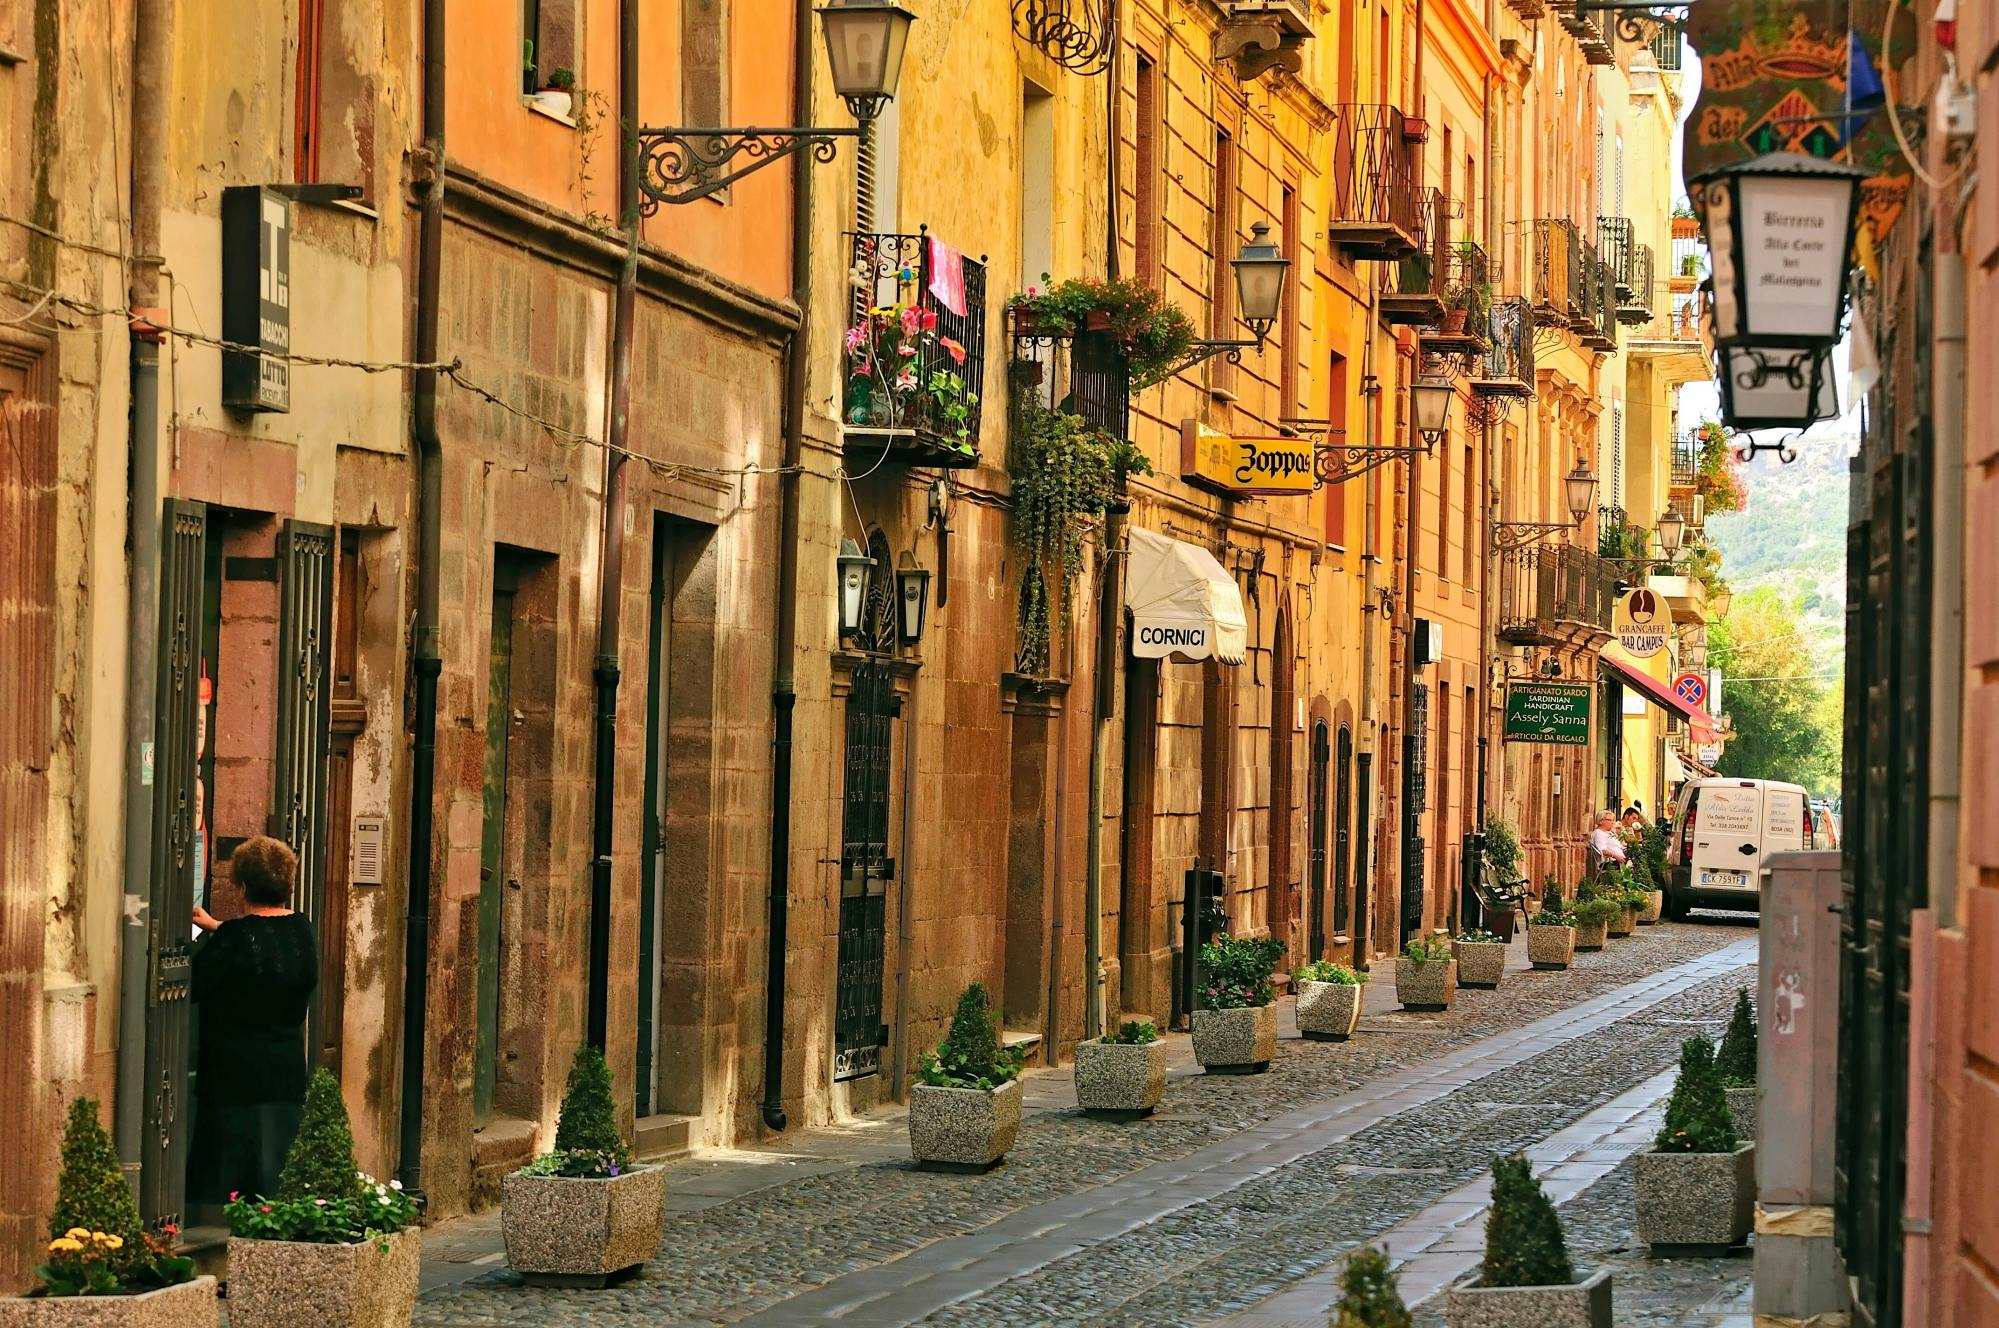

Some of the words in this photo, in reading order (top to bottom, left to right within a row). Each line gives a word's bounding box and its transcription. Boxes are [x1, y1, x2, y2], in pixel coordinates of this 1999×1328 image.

[1709, 54, 1757, 89] Alla
[1707, 110, 1741, 139] dei
[260, 318, 289, 349] TABACCHI
[262, 358, 287, 387] LOTTO
[1235, 443, 1310, 484] Zoppas
[1140, 627, 1205, 647] CORNICI
[1621, 635, 1635, 650] BAR
[1636, 635, 1664, 651] CAMPUS
[1512, 686, 1562, 696] ARTIGIANATO
[1563, 688, 1588, 697] SARDO
[1528, 695, 1571, 704] SARDINIAN
[1524, 702, 1575, 712] HANDICRAFT
[1510, 710, 1550, 726] Assely
[1552, 713, 1587, 726] Sanna
[1544, 733, 1555, 741] DA
[1556, 734, 1585, 743] REGALO
